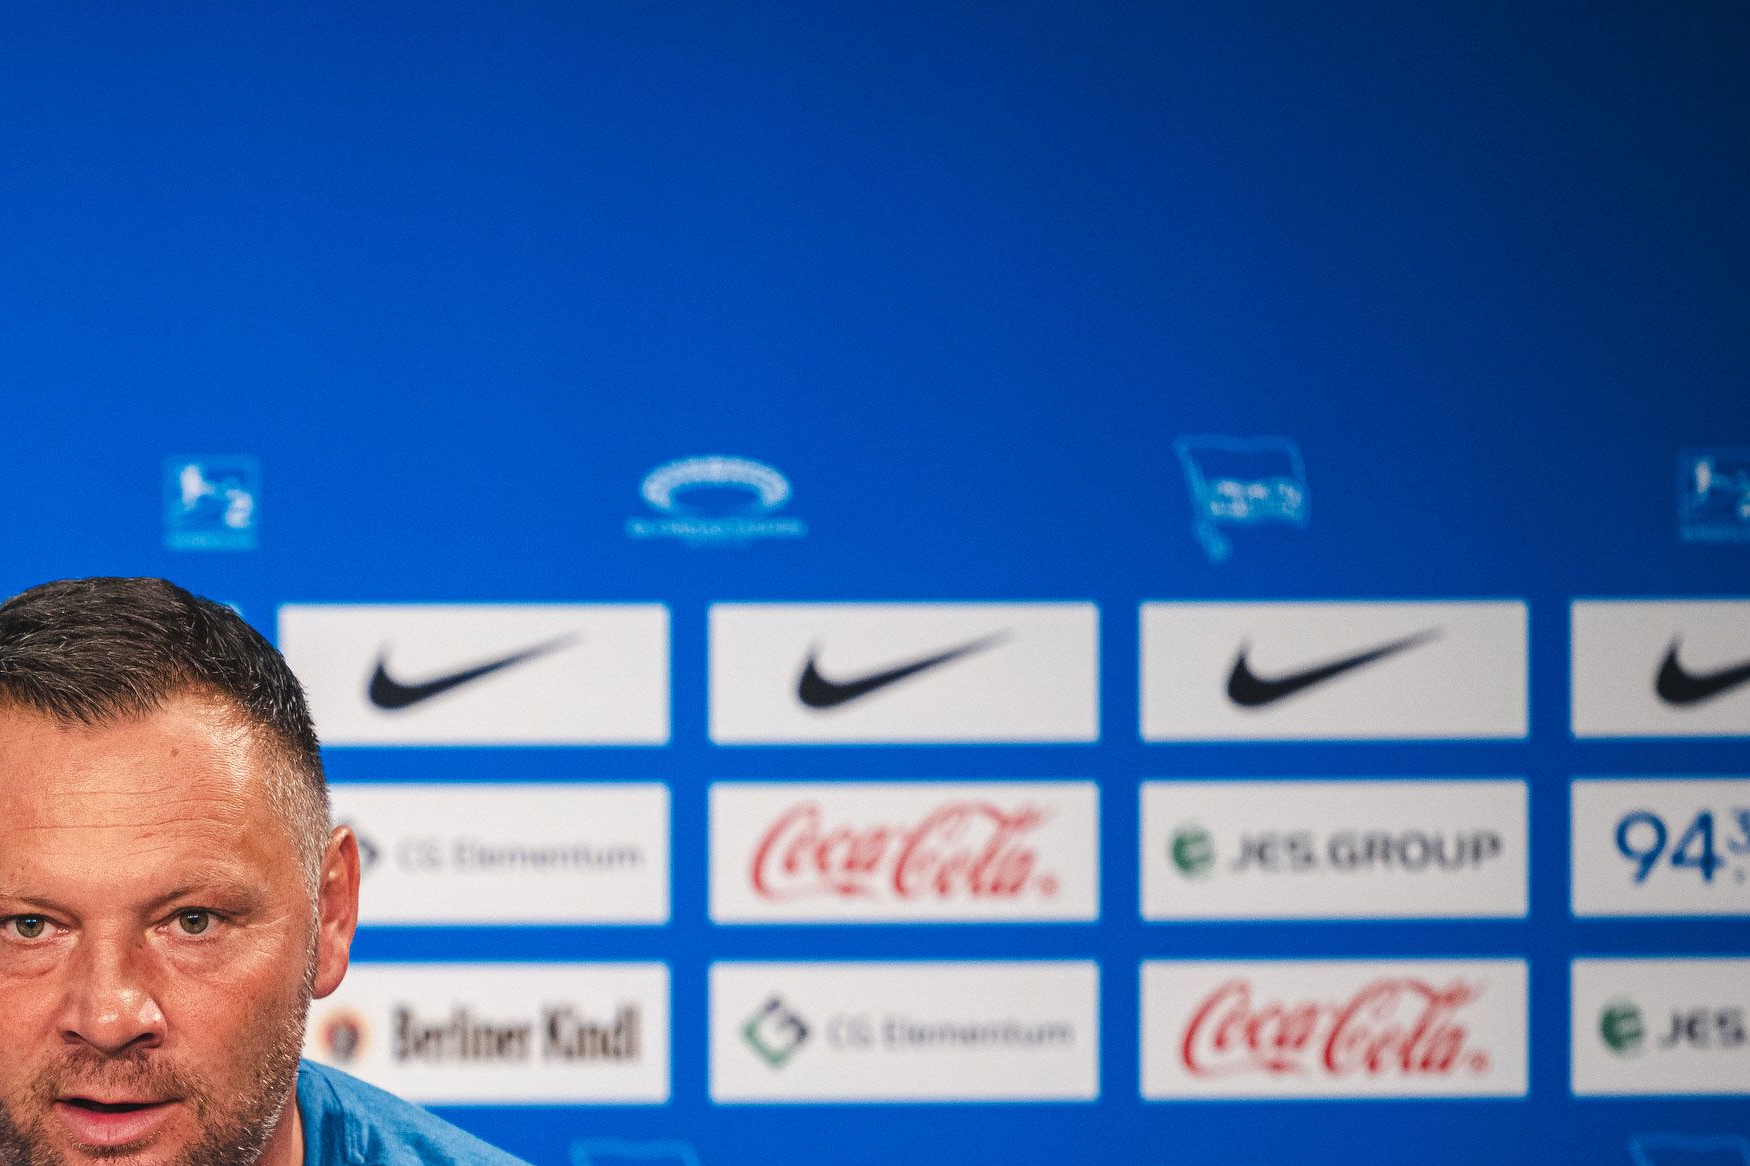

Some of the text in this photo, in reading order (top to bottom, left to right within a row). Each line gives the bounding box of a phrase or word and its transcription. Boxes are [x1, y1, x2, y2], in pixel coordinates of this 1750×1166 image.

[452, 837, 644, 873] Elementum
[392, 1001, 641, 1064] Berliner Kindl
[881, 1014, 1073, 1052] Elementum
